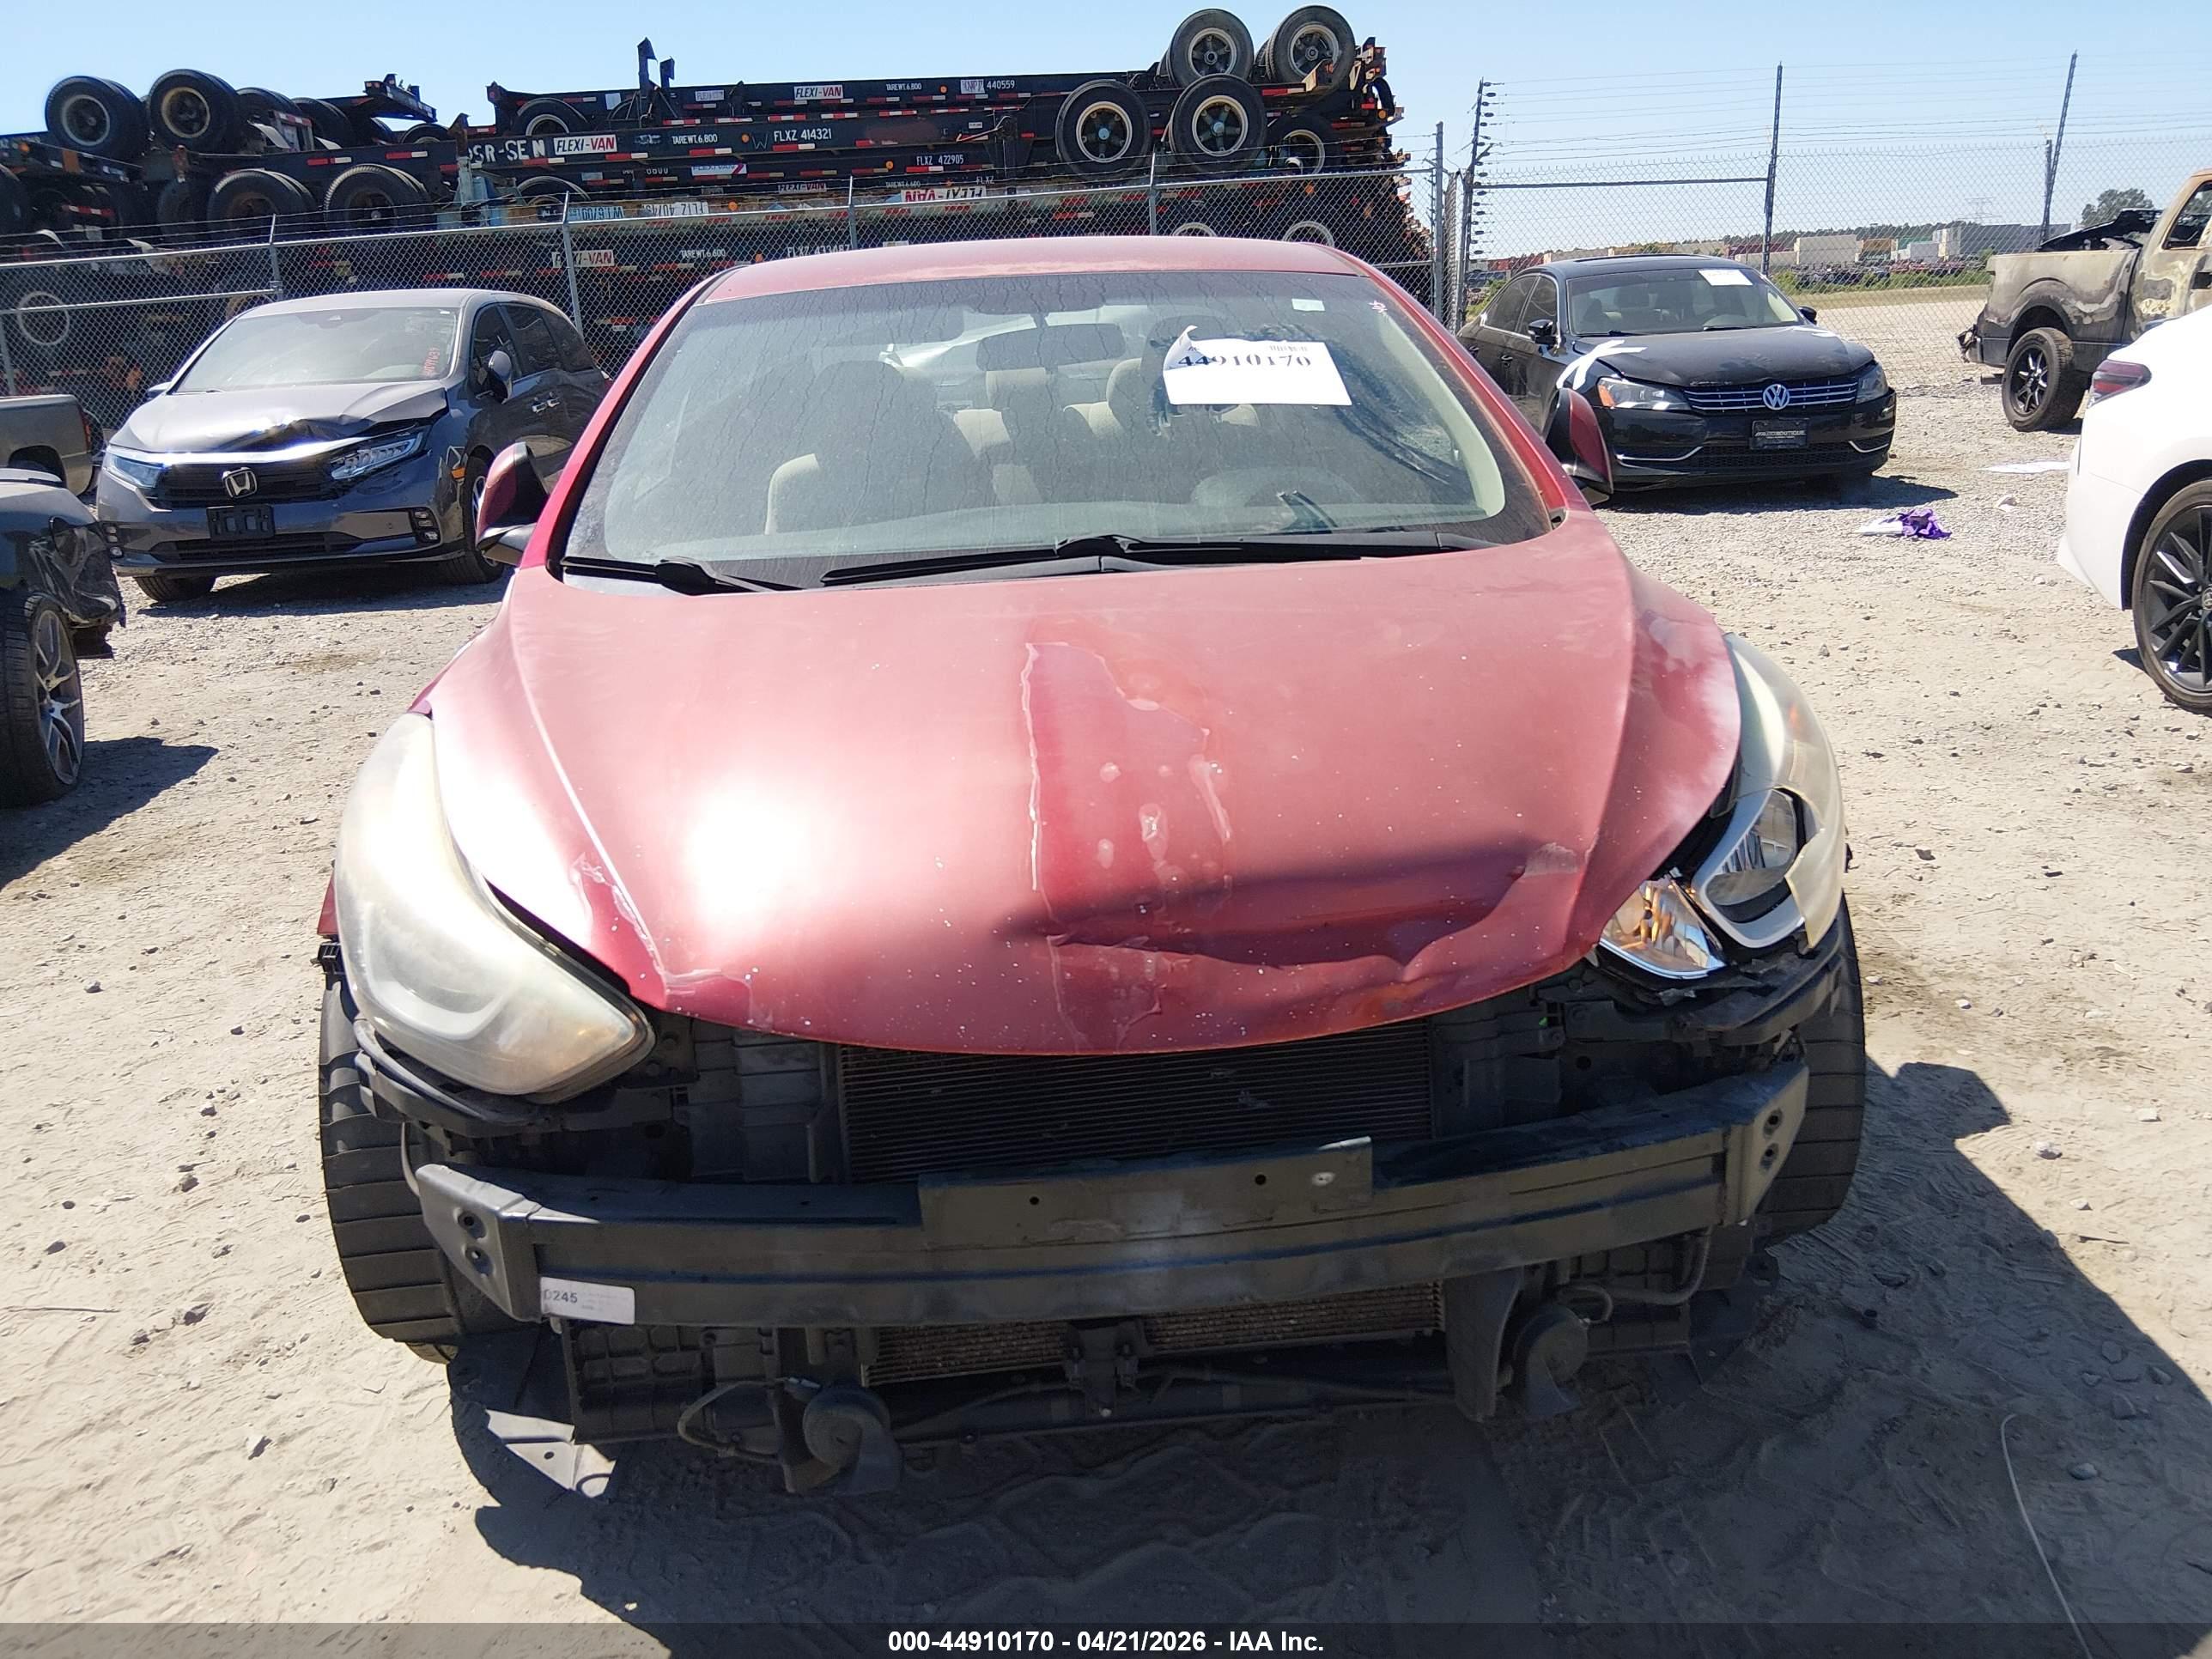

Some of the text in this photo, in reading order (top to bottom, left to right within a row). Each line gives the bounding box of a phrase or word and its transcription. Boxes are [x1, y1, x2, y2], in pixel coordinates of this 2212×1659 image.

[987, 80, 1015, 90] 440559
[795, 87, 842, 97] FLEXI-VAN
[774, 128, 832, 142] FLXZ 414321
[557, 137, 615, 153] FLEXI-VAN
[916, 155, 964, 166] FLXZ 422905
